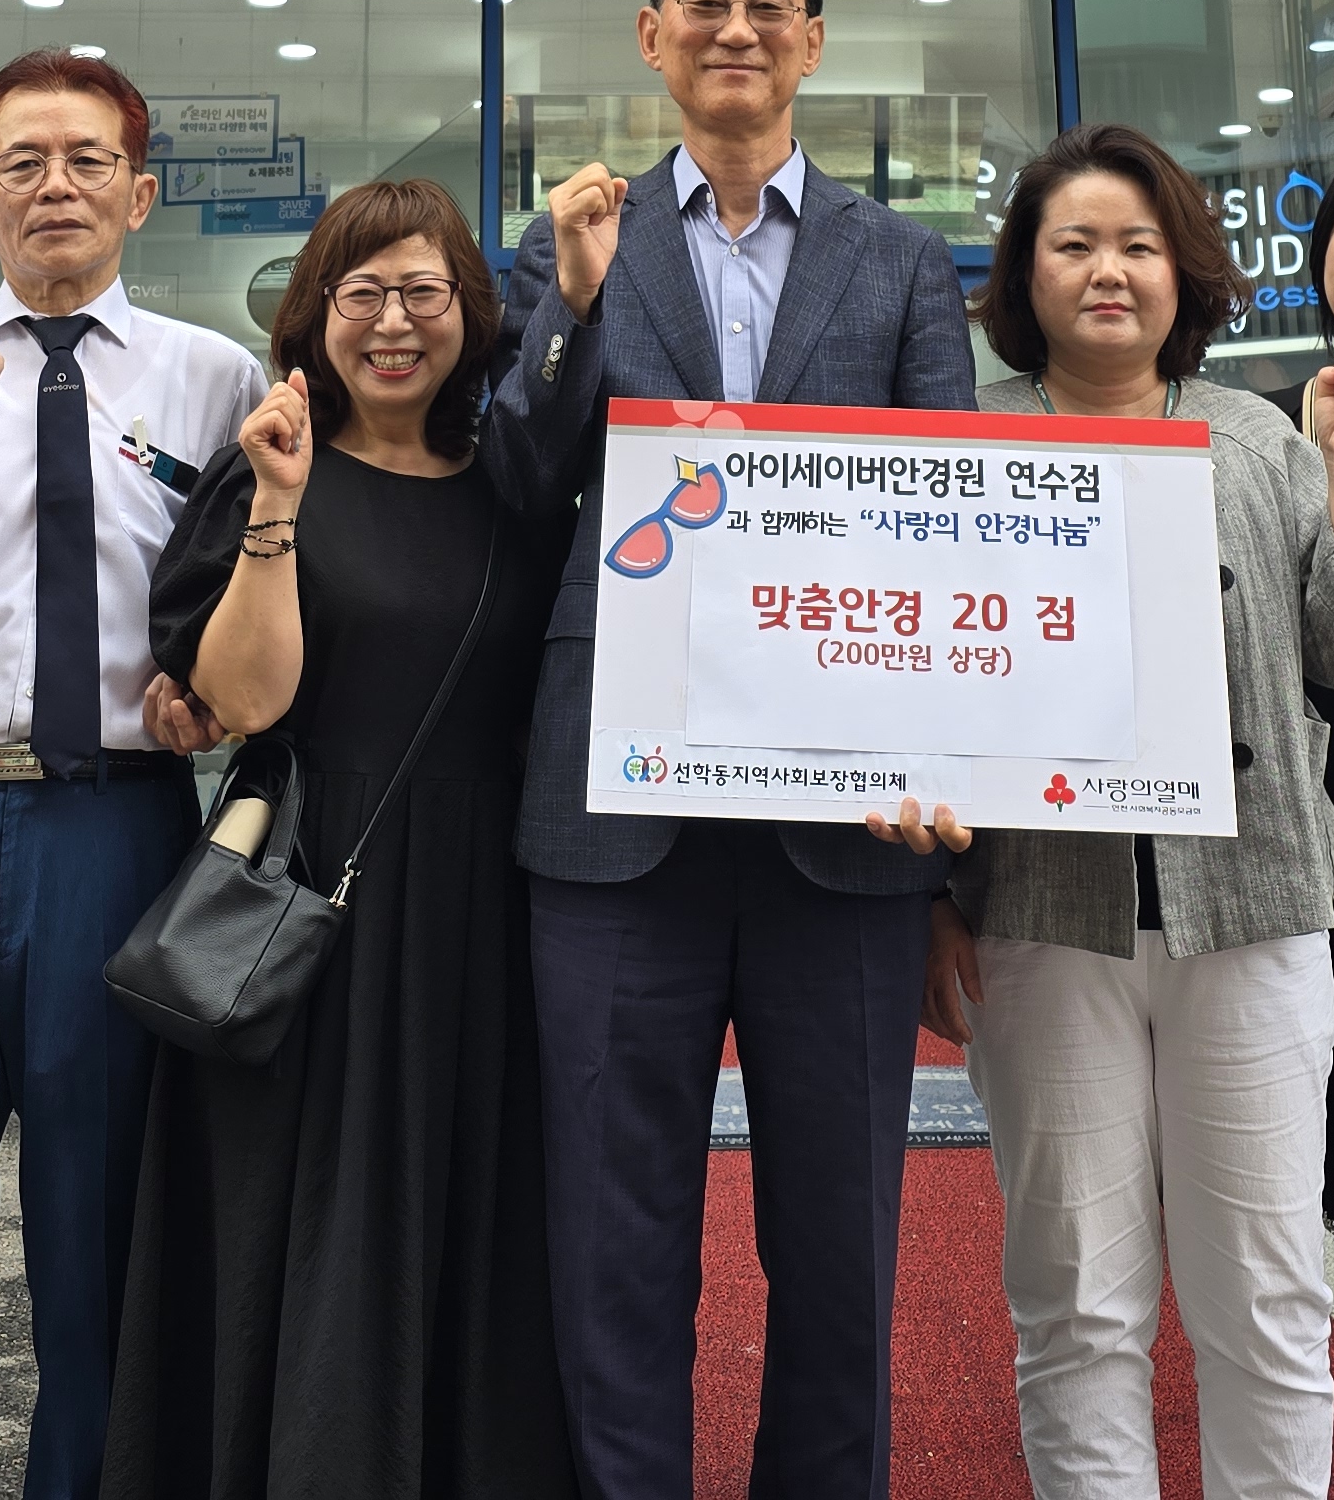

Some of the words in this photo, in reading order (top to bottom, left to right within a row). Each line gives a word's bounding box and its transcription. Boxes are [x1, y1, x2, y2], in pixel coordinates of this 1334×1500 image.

[279, 200, 311, 209] SAVER
[128, 285, 170, 298] aver
[43, 384, 80, 393] eyesaver
[726, 451, 985, 498] 아이세이버안경원
[1004, 463, 1101, 502] 연수점
[727, 510, 750, 532] 과
[760, 510, 848, 537] 함께하는
[860, 509, 961, 543] “사랑의
[976, 514, 1101, 547] 안경나눔”
[752, 583, 921, 637] 맞춤안경
[953, 593, 1009, 633] 20
[1035, 596, 1076, 643] 점
[817, 642, 933, 672] (200만원
[947, 644, 1013, 677] 상당)
[672, 762, 907, 793] 선학동지역사회보장협의체
[1082, 778, 1201, 804] 사랑의열매
